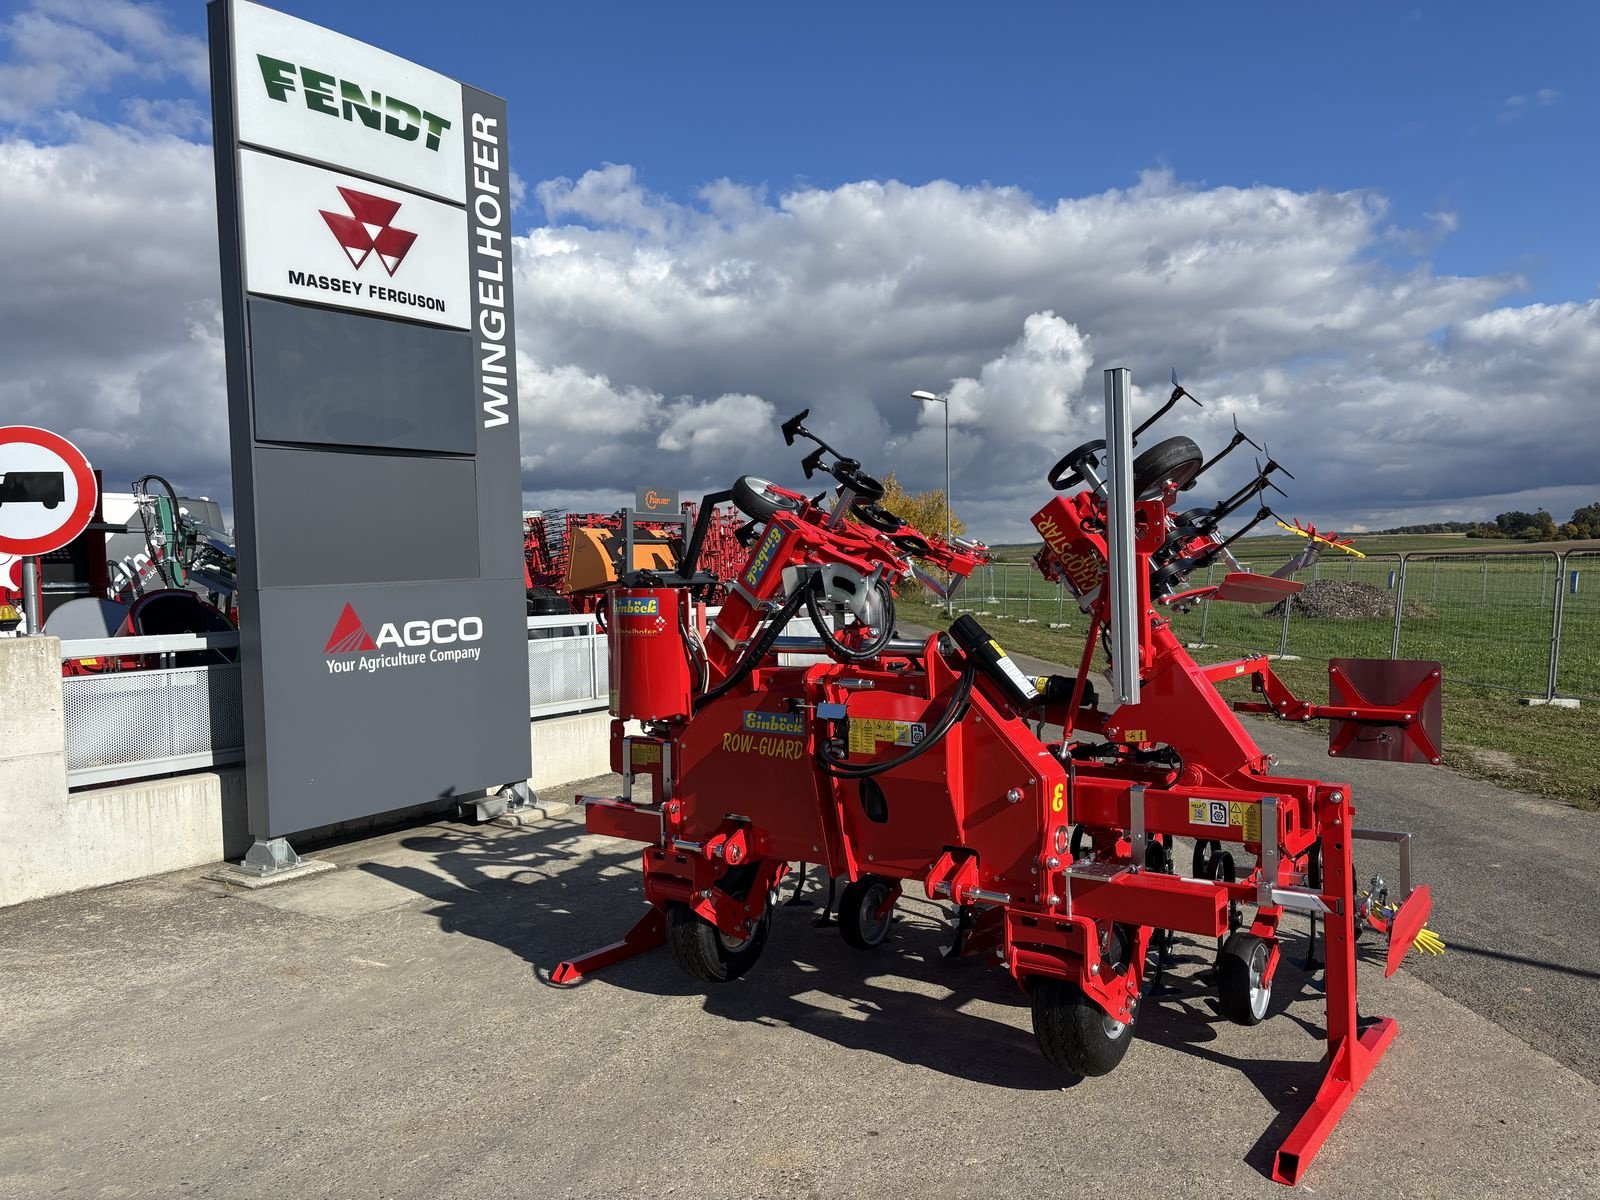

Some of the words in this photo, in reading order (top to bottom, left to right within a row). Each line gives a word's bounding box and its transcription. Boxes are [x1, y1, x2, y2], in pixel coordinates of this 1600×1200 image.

[256, 53, 452, 152] FENDT
[288, 270, 363, 295] MASSEY
[369, 284, 446, 312] FERGUSON
[471, 112, 510, 428] WINGELHOFER
[746, 527, 781, 585] Einböck
[375, 616, 484, 649] AGCO
[326, 659, 356, 674] Your
[358, 651, 427, 673] Agriculture
[429, 647, 481, 663] Company
[722, 732, 804, 760] ROW-GUARD
